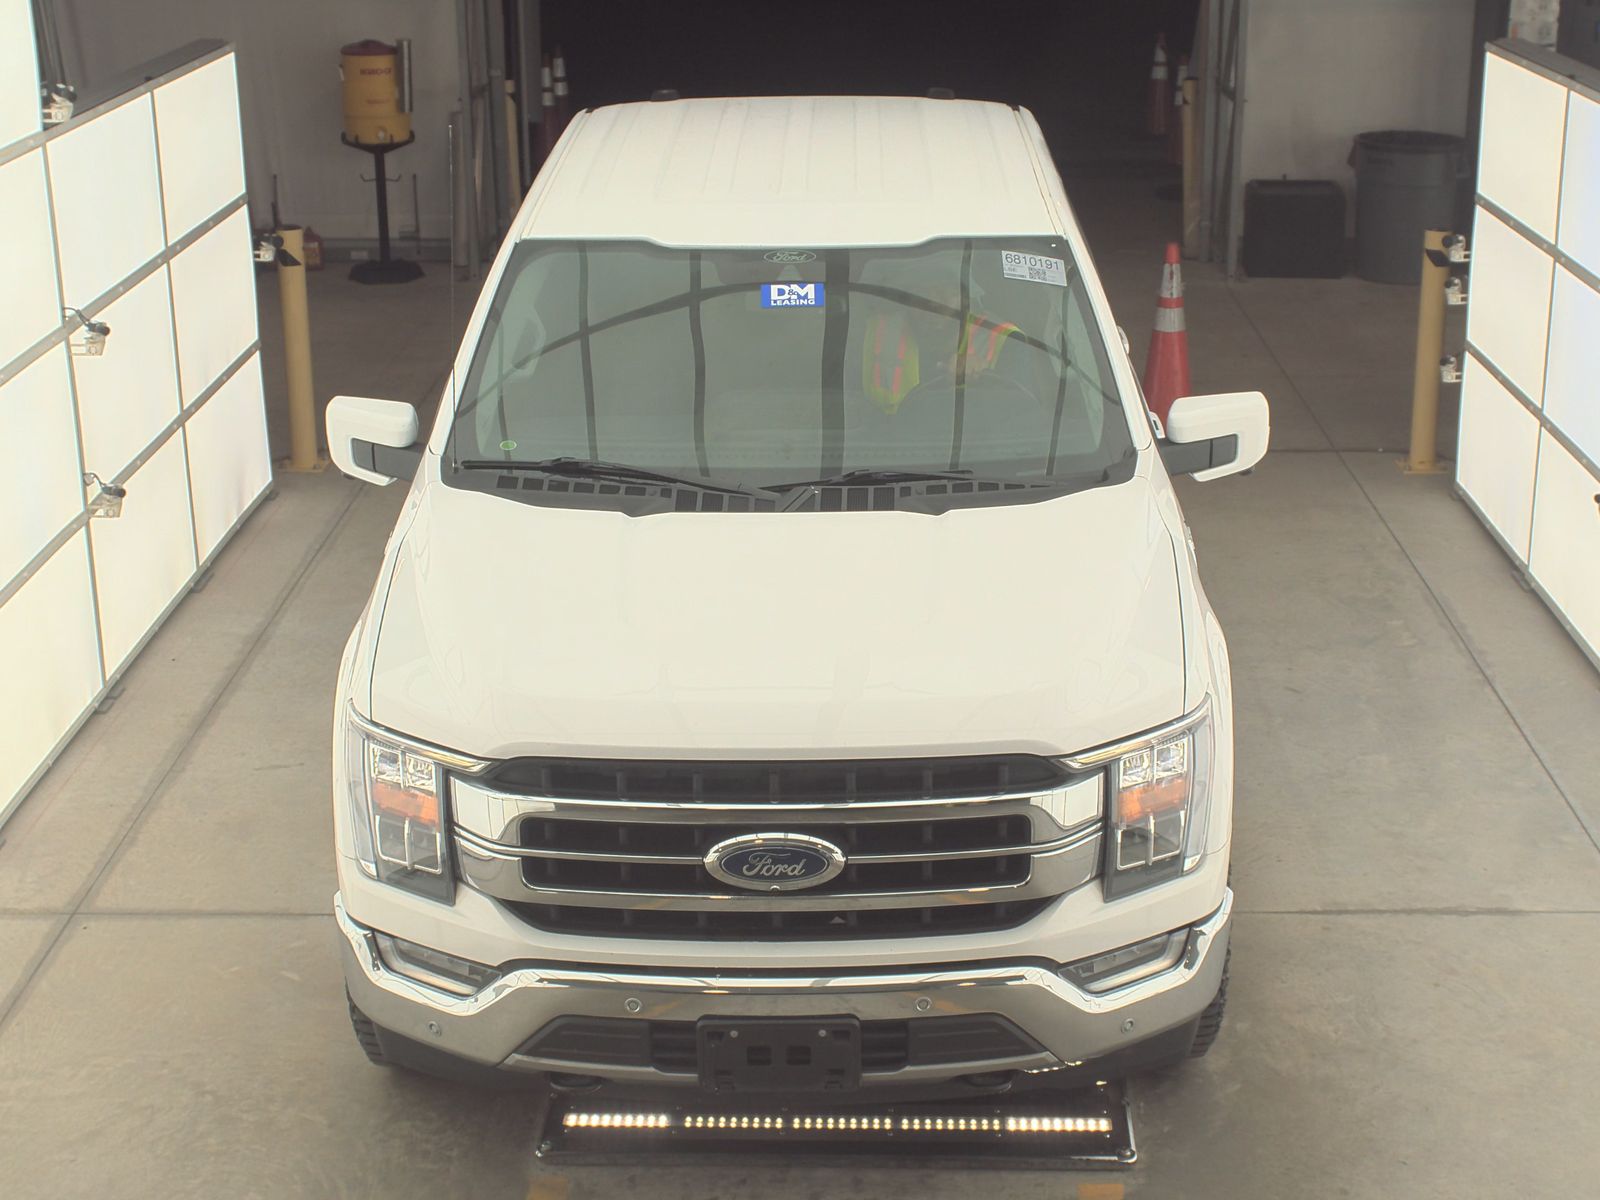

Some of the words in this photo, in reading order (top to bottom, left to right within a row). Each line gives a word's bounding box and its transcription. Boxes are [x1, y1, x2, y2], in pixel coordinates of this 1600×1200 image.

[773, 251, 808, 261] Ford
[1005, 253, 1059, 270] 6810191
[770, 283, 815, 300] D&M
[742, 851, 806, 877] Ford
